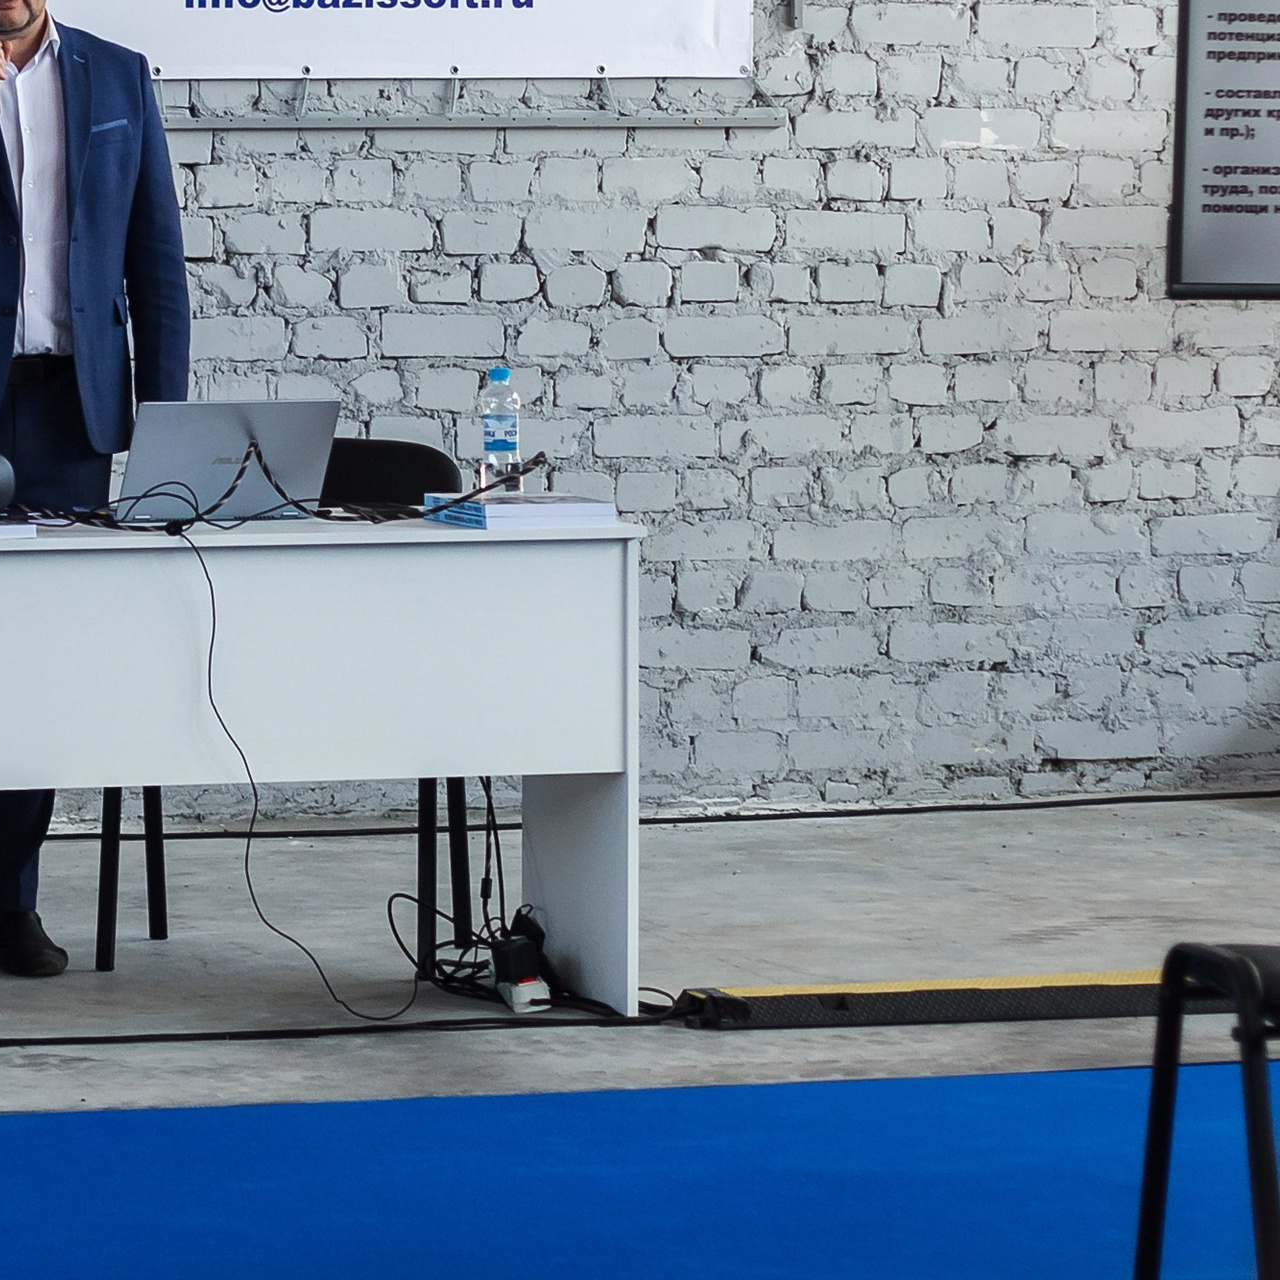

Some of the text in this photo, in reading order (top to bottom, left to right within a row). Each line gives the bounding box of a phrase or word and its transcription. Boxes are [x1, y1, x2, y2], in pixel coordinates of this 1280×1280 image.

[1203, 107, 1262, 121] других
[1203, 124, 1256, 140] и пр.);
[1201, 184, 1254, 198] труда,
[1201, 203, 1269, 216] помощи
